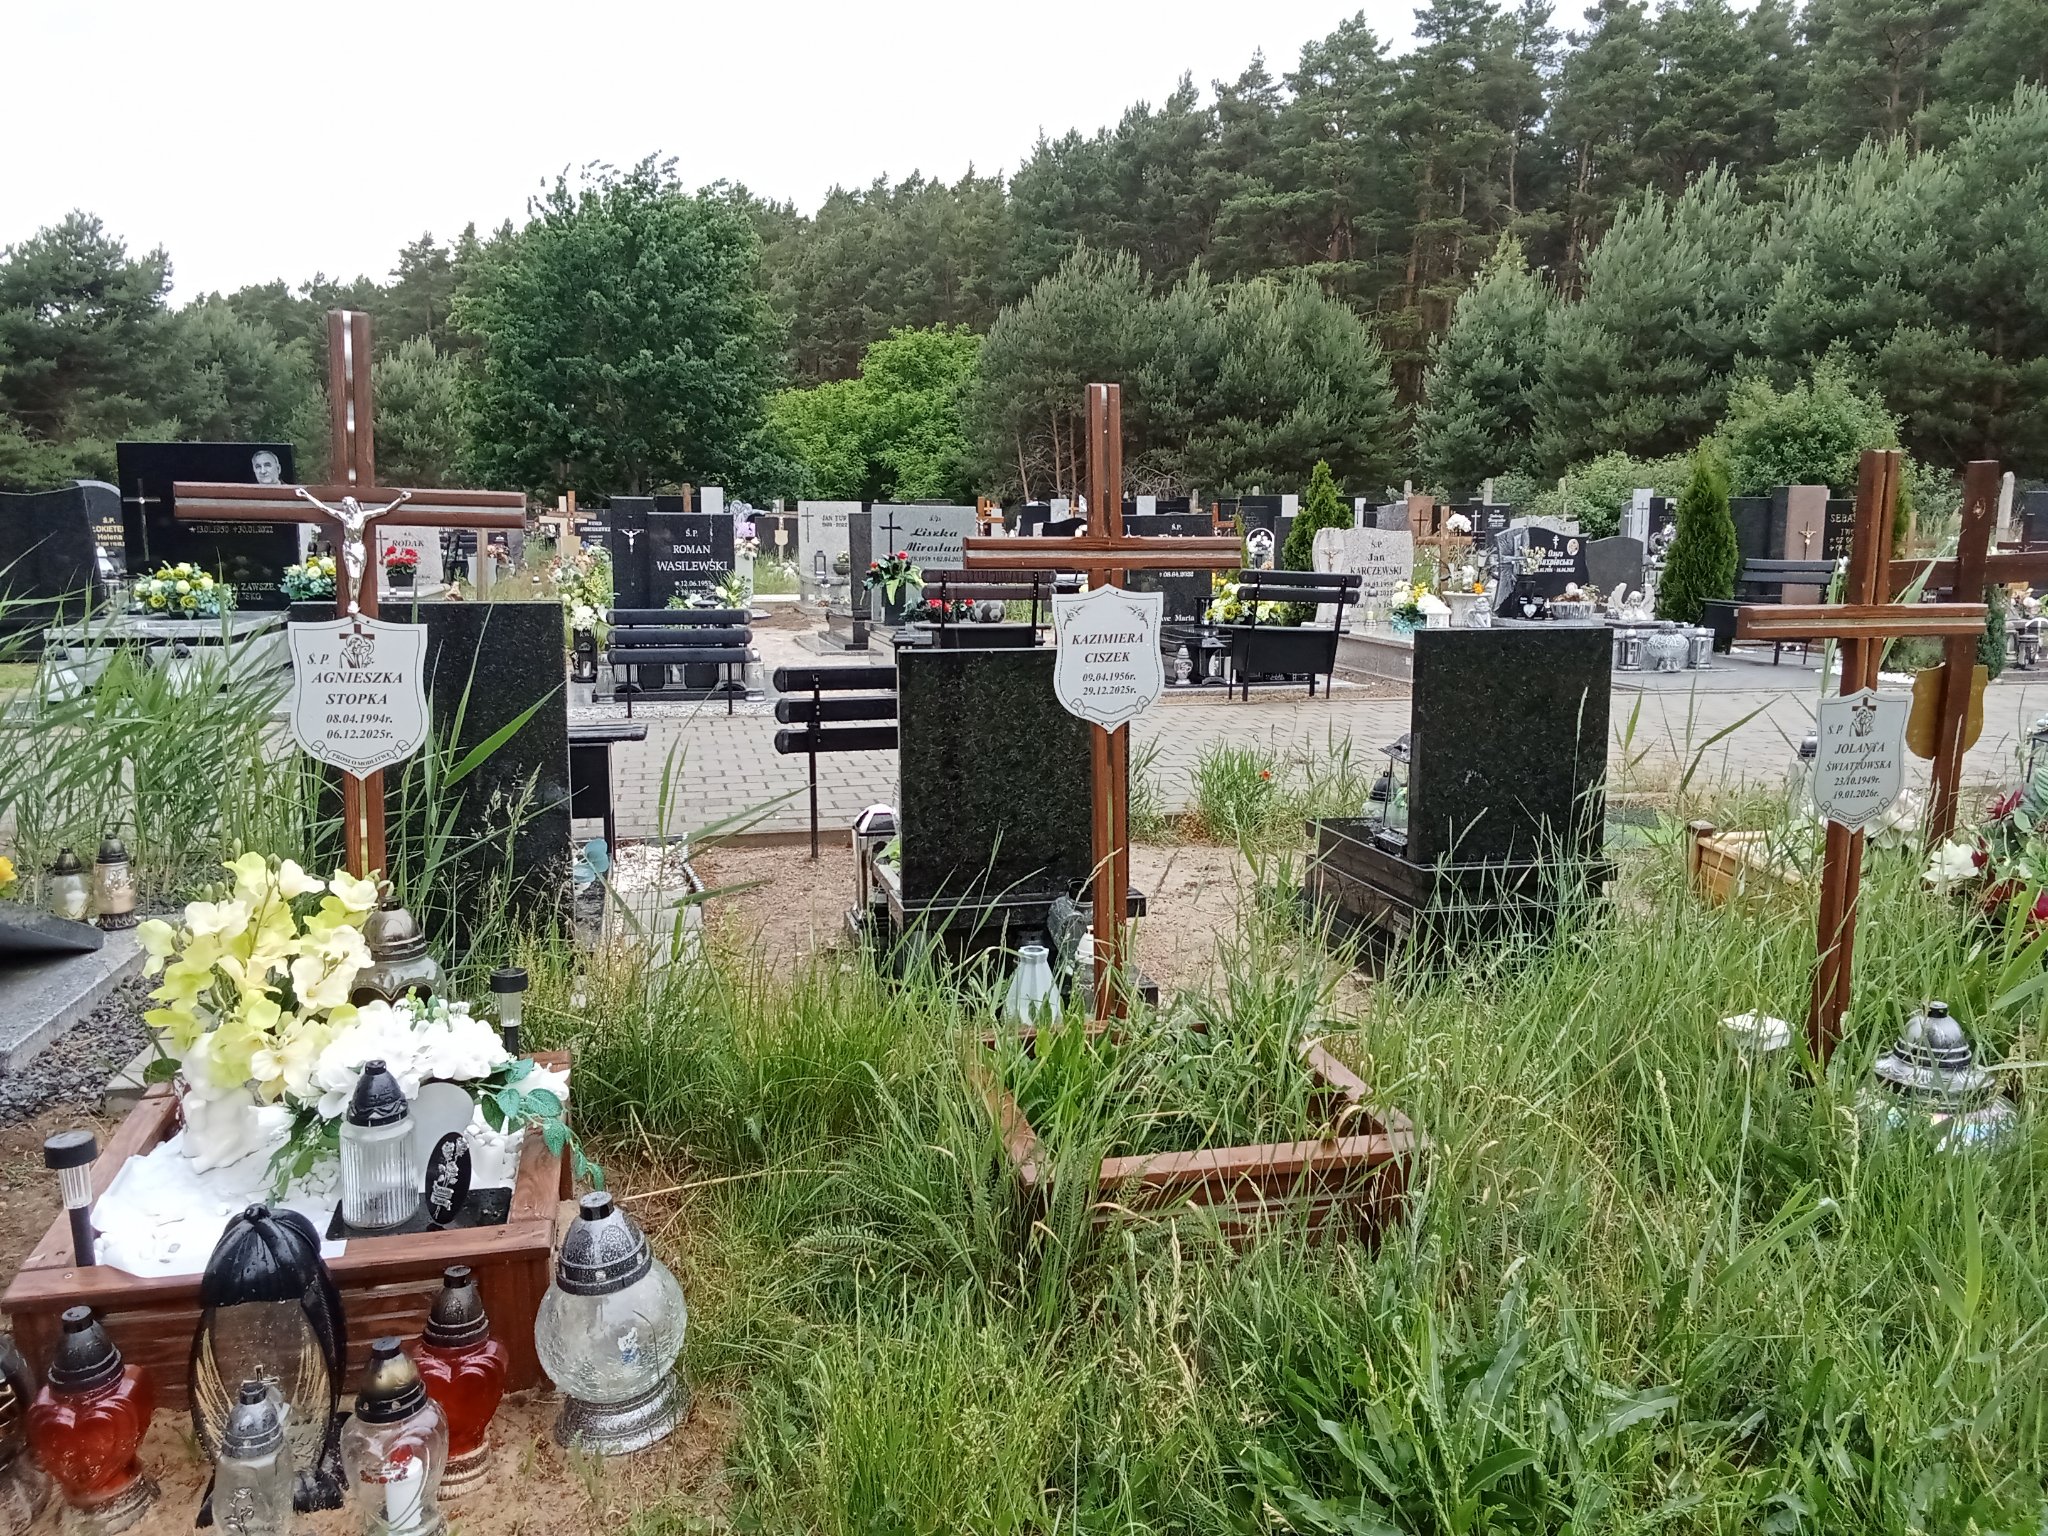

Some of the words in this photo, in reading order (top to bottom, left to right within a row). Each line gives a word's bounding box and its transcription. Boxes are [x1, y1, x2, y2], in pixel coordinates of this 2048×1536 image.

[910, 527, 958, 537] Liszka
[673, 545, 711, 554] ROMAN
[1368, 553, 1385, 561] Jan
[1350, 566, 1402, 576] KARCZEWSKI
[1175, 614, 1195, 622] Maria
[1072, 633, 1144, 645] KAZIMIERA
[1084, 652, 1130, 664] CISZEK
[311, 672, 403, 684] AGNIESZKA
[1082, 672, 1136, 682] 09.04.1956r.
[1082, 686, 1137, 696] 29.12.2025r.
[325, 693, 388, 705] STOPKA
[326, 713, 393, 724] 08.04.1994r.
[326, 729, 394, 739] 06.12.2025r.
[1835, 742, 1886, 754] JOLANTA
[332, 752, 351, 765] PROSI
[1833, 790, 1880, 800] 19.01.2026r.
